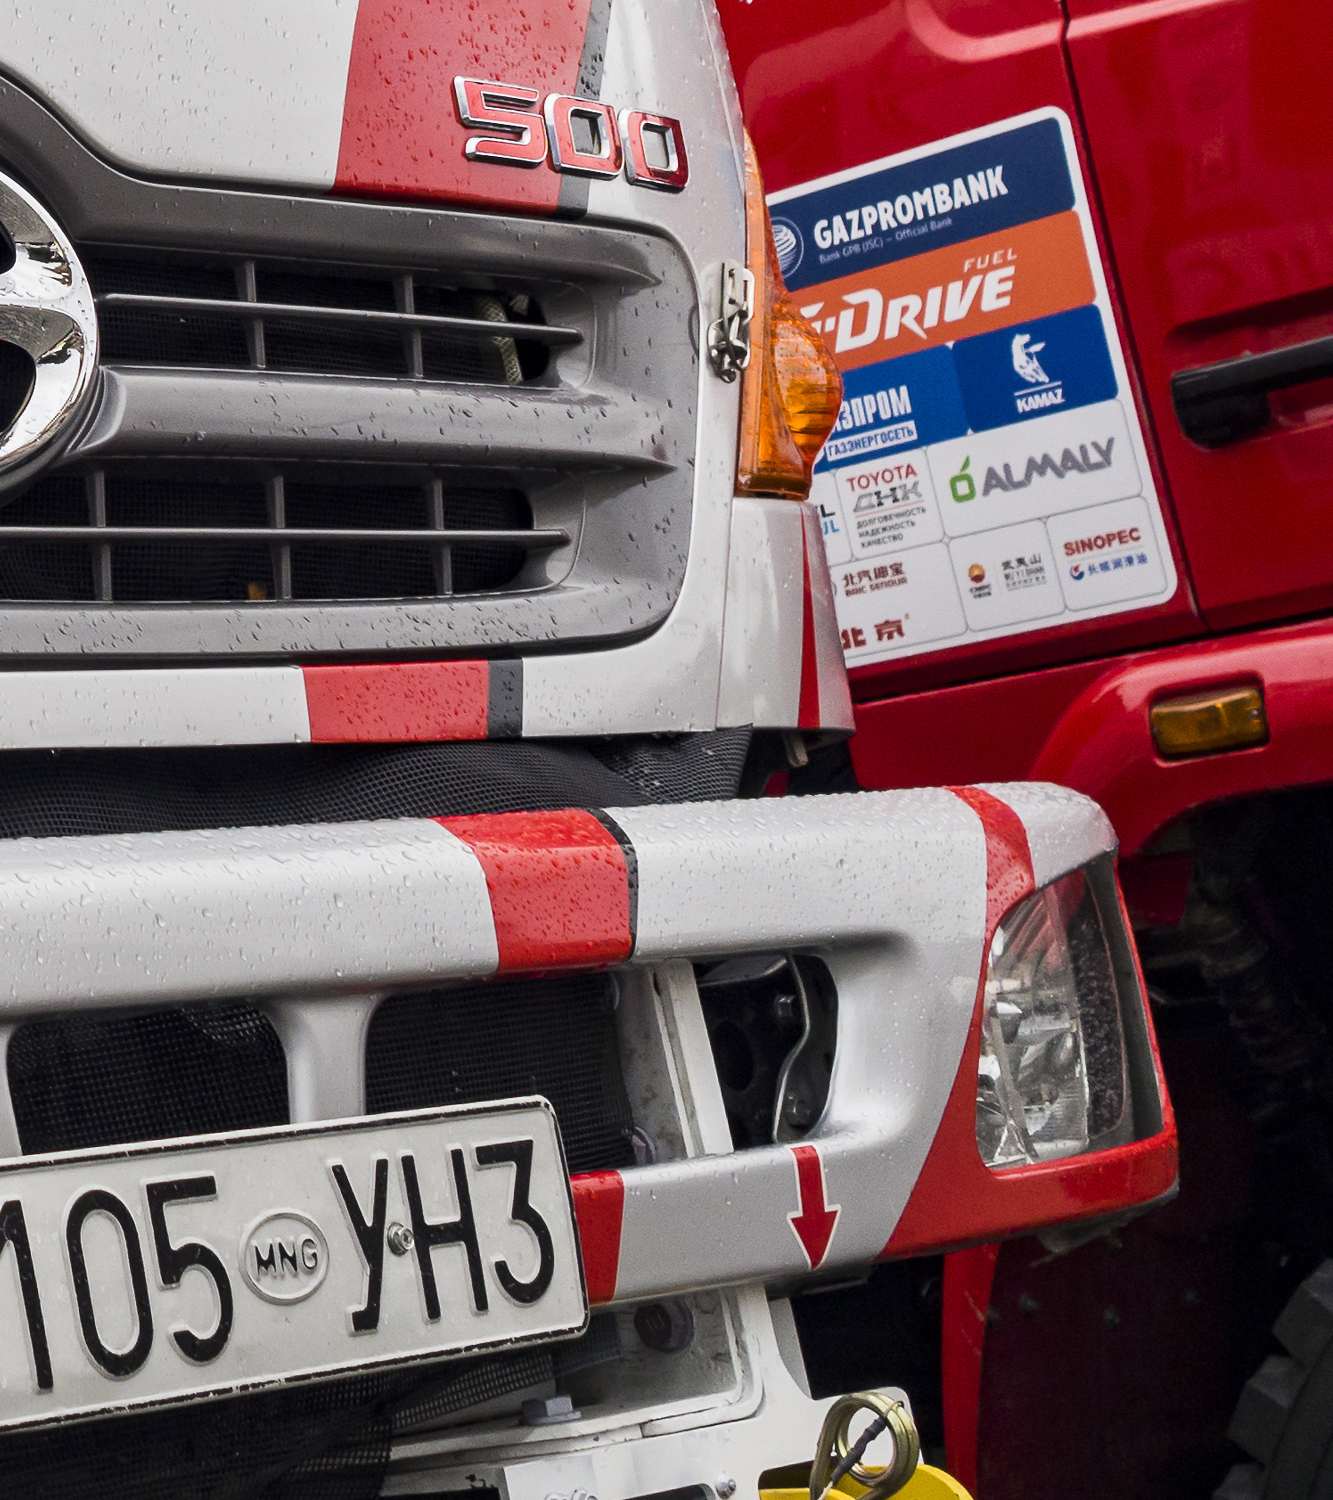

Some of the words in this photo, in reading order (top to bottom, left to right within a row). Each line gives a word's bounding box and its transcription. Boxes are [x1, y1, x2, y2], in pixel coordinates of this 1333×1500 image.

[452, 75, 691, 193] 500
[814, 165, 1009, 249] GAZPROMBANK
[963, 247, 1018, 273] FUEL
[1016, 388, 1066, 414] KAMAZ
[846, 463, 918, 492] TOYOTA
[982, 437, 1115, 497] ALMALY
[1063, 526, 1141, 557] SINOPEC
[253, 1237, 318, 1278] MNG
